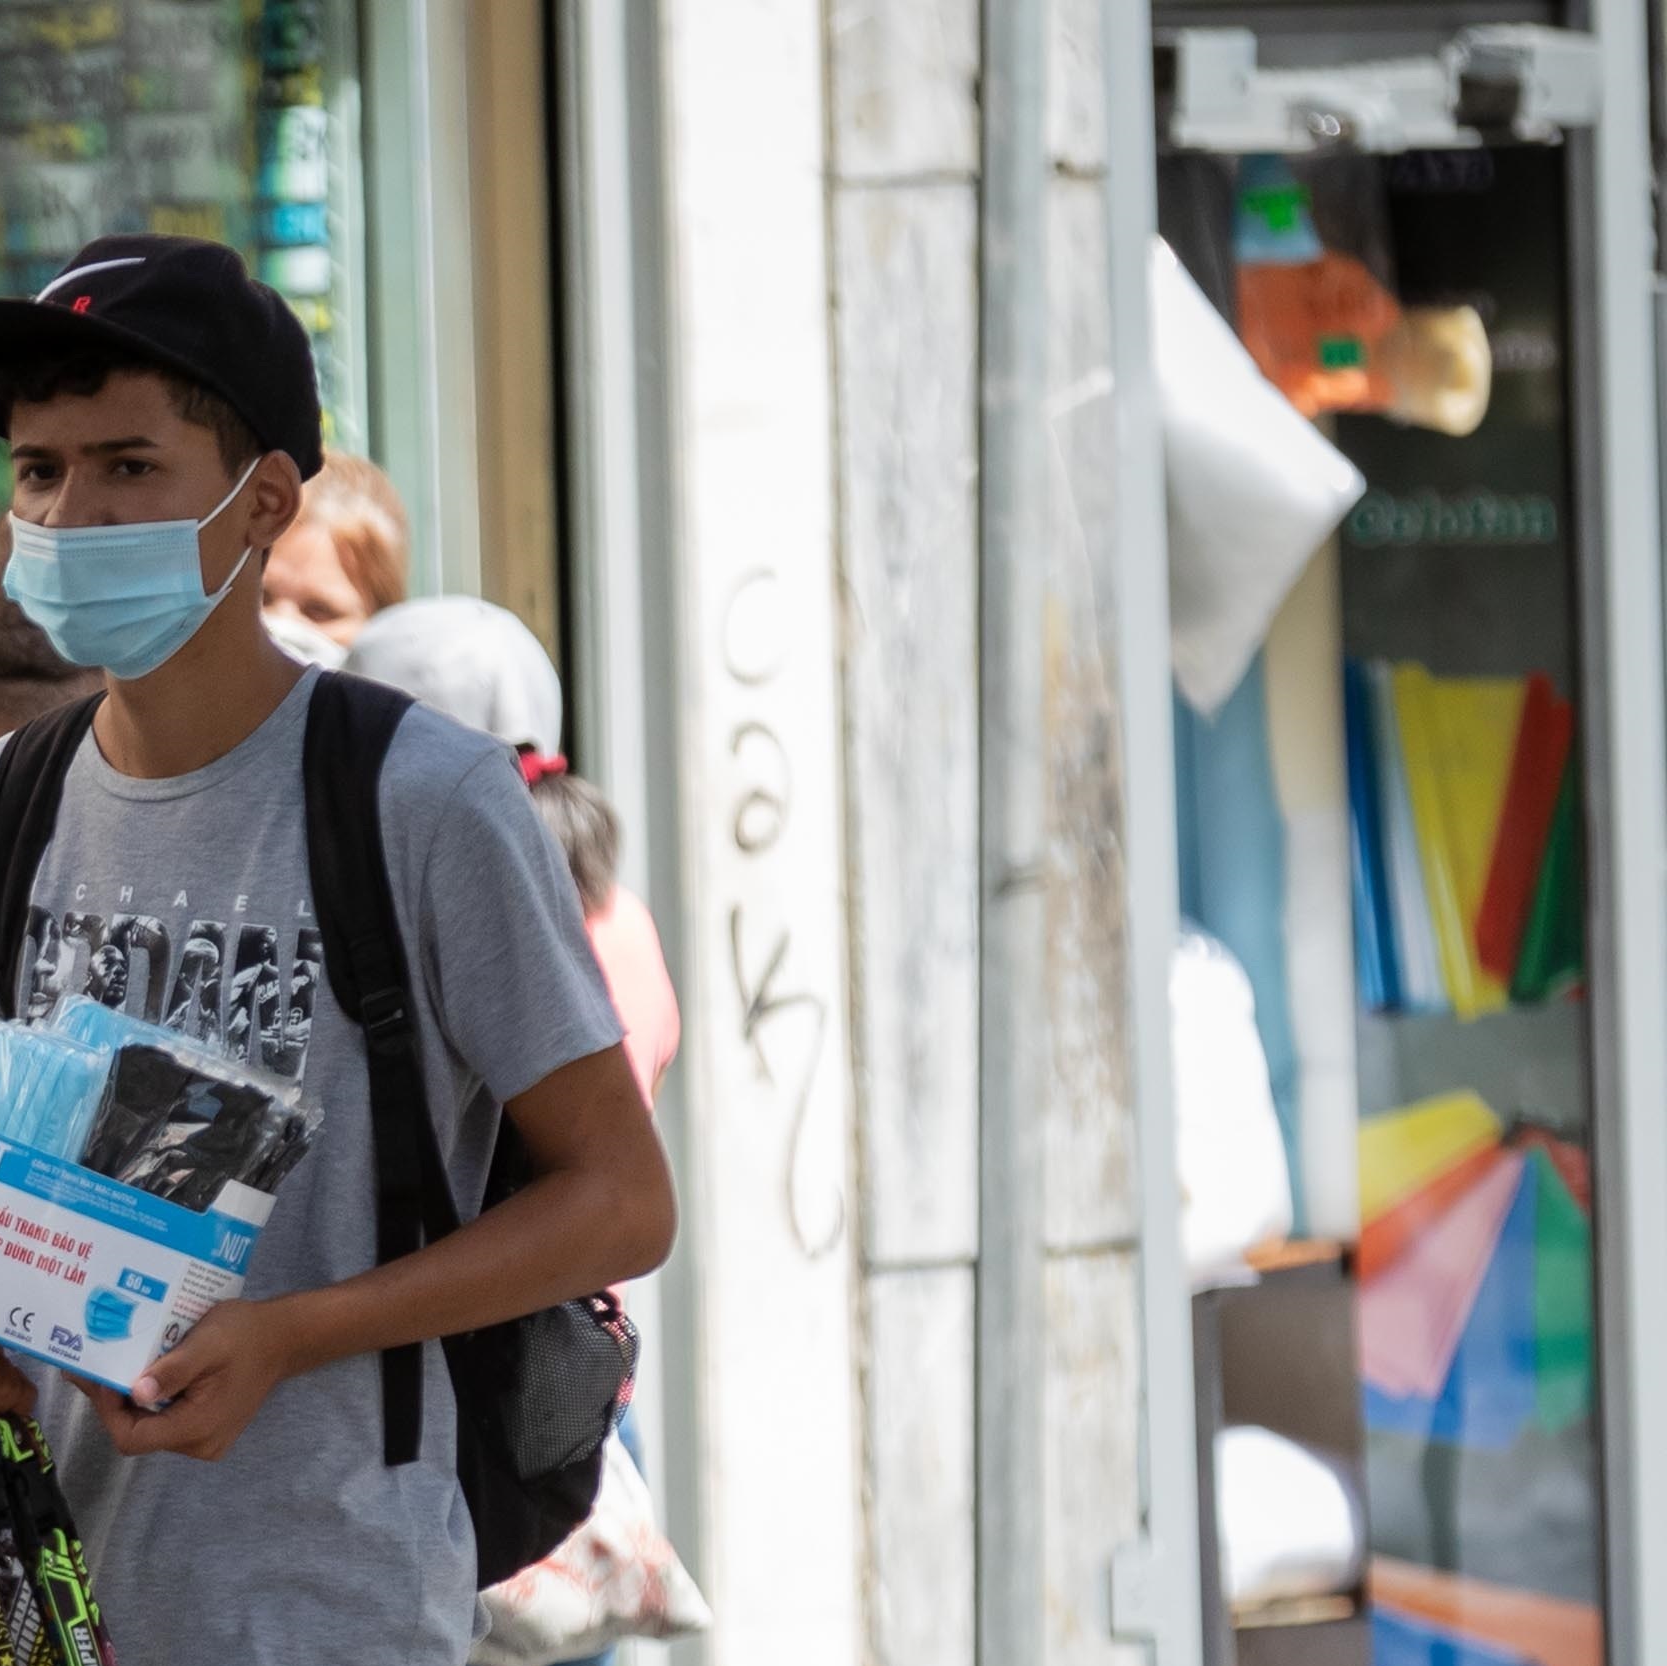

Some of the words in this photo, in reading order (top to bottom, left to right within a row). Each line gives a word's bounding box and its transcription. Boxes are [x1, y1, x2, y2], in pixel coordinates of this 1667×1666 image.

[14, 1217, 51, 1243] TRANG
[218, 1231, 252, 1265] NUT
[9, 1306, 36, 1333] CE
[50, 1325, 84, 1352] FDA
